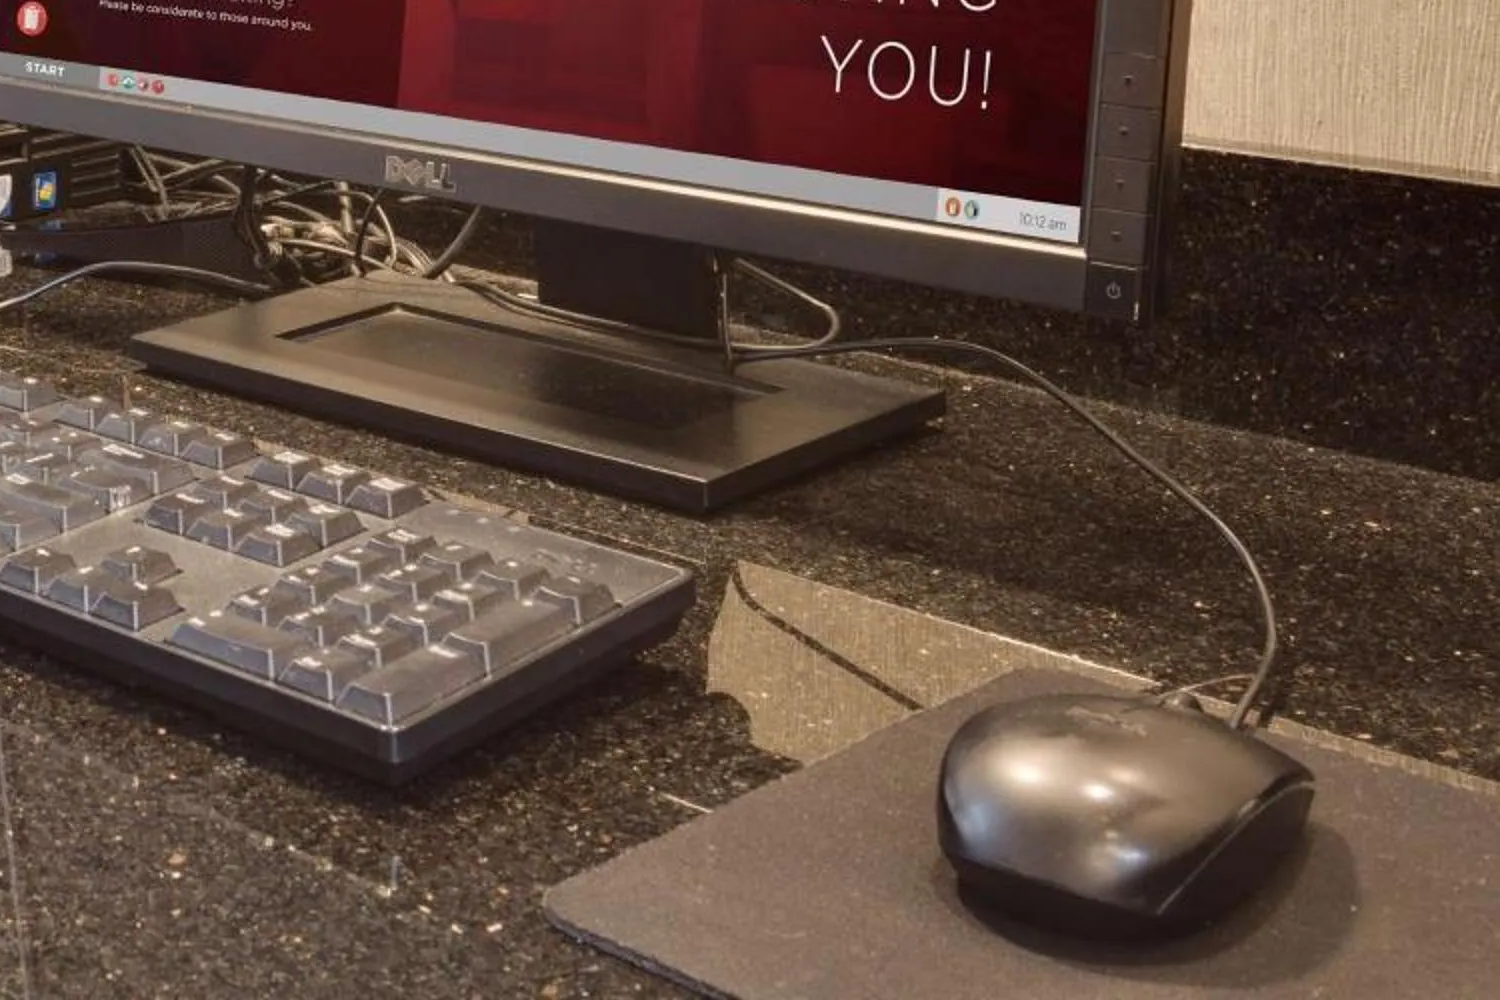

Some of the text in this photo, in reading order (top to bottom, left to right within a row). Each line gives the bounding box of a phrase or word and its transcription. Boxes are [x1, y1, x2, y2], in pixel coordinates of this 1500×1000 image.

[132, 1, 145, 13] be
[146, 3, 204, 19] considerate
[206, 9, 218, 21] to
[219, 10, 249, 24] those
[251, 15, 289, 29] around
[291, 21, 313, 33] you.
[25, 61, 65, 77] START
[820, 34, 992, 110] YOU!
[385, 155, 457, 193] DELL
[1048, 219, 1067, 231] am
